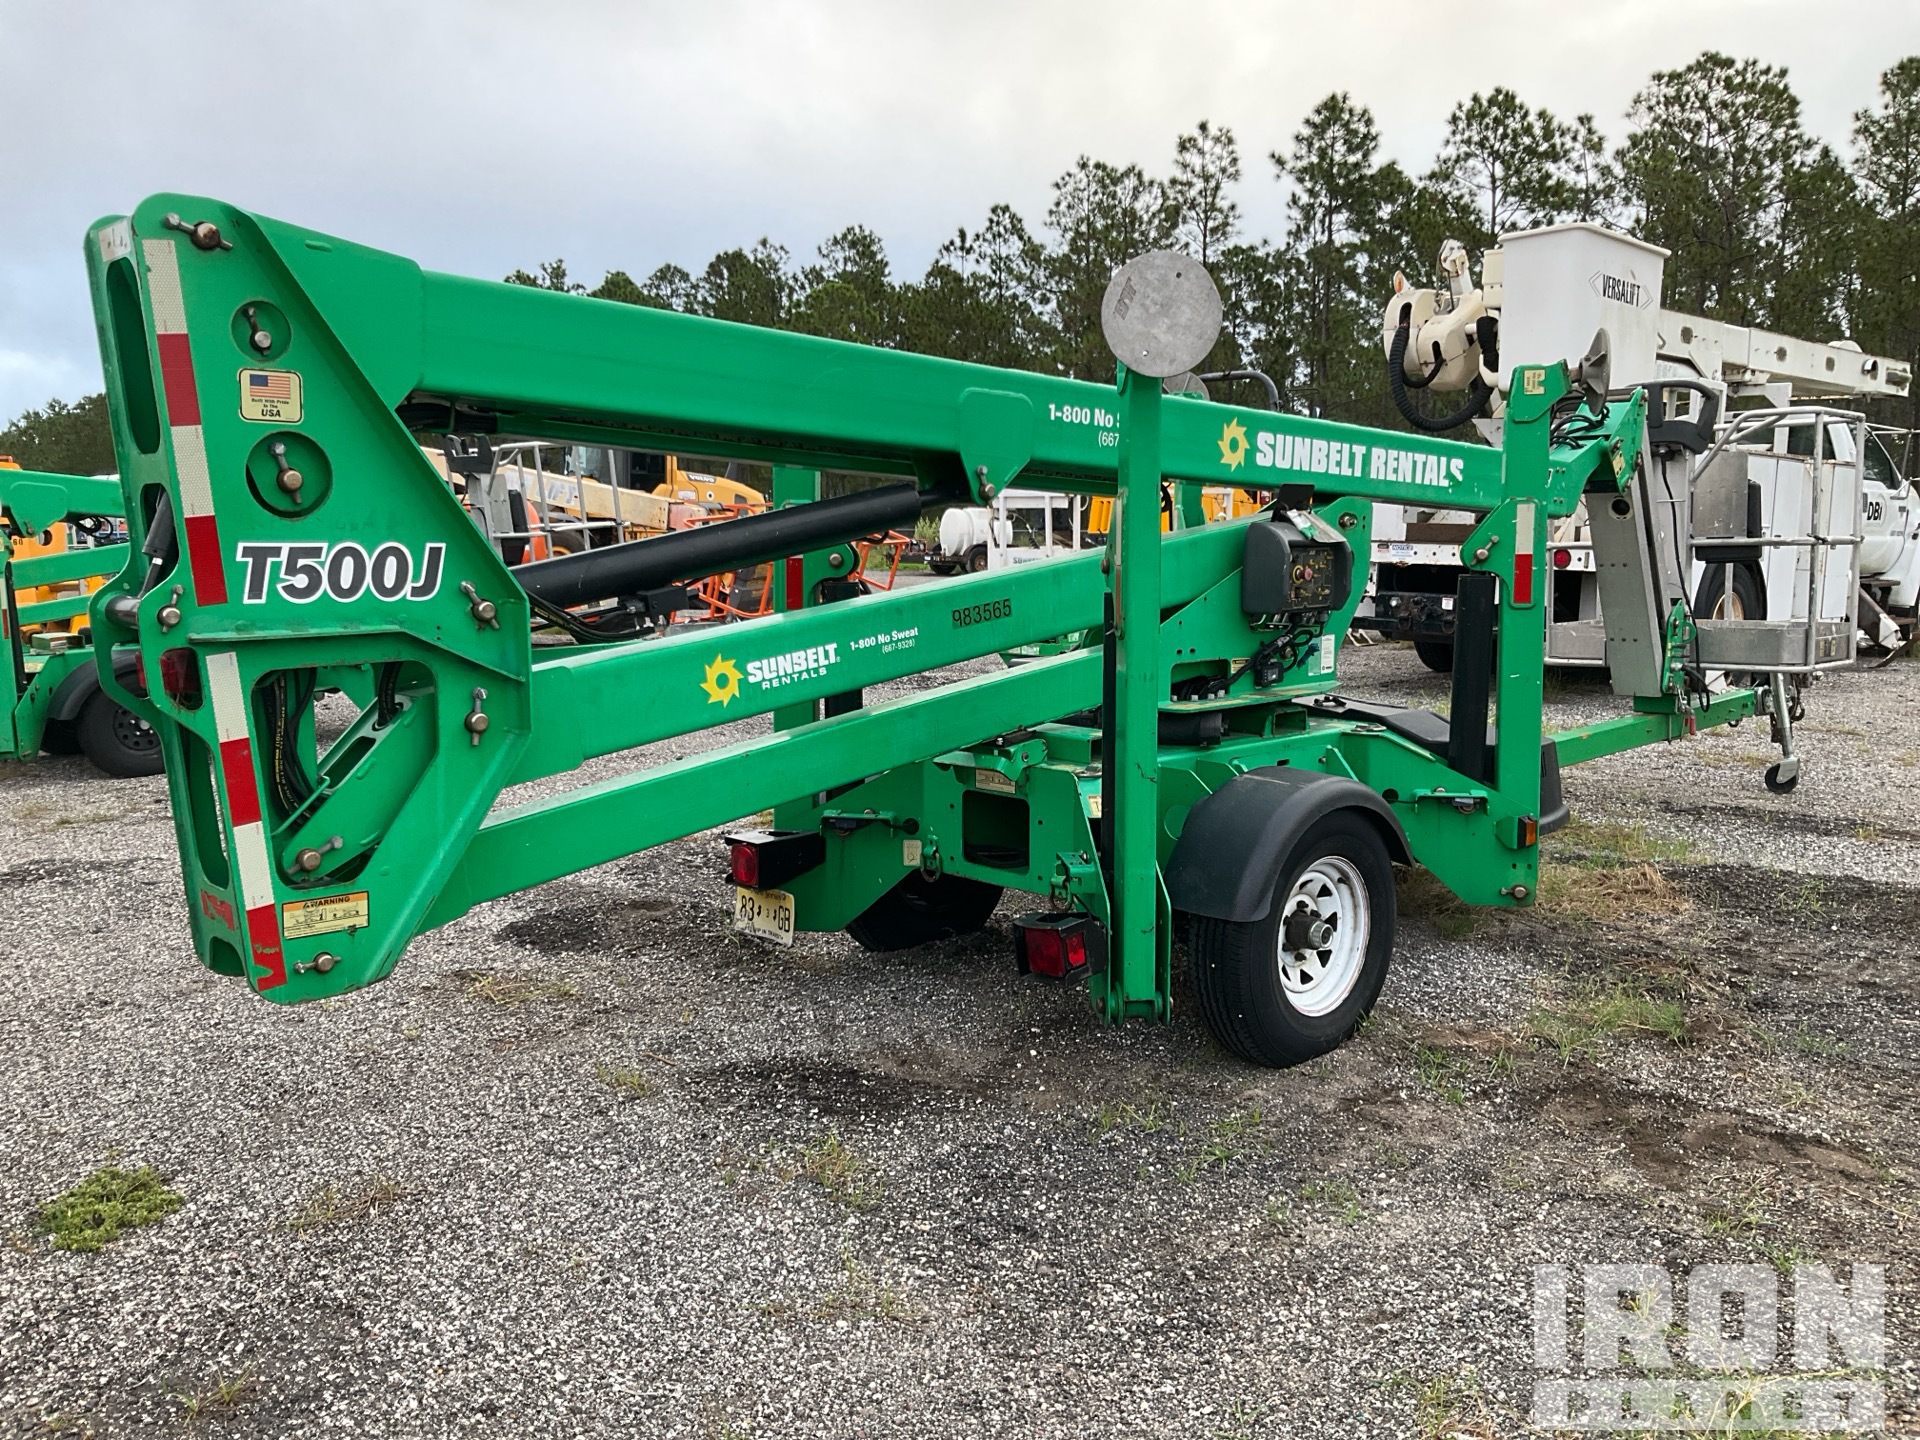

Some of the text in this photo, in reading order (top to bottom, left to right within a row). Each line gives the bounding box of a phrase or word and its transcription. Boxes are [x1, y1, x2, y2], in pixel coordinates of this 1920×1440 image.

[1603, 274, 1641, 307] VERSALIFT
[261, 408, 281, 418] USA
[1048, 403, 1091, 425] 1-800
[1093, 408, 1114, 428] No
[1255, 432, 1464, 488] SUNBELT RENTALS
[688, 474, 715, 483] VOLVO
[236, 542, 447, 604] T500J
[952, 598, 1012, 628] 983565
[850, 627, 919, 651] 1-800 No Sweat
[881, 637, 916, 655] (667-9328)
[746, 643, 837, 684] SUNBELT
[762, 667, 828, 690] RENTALS
